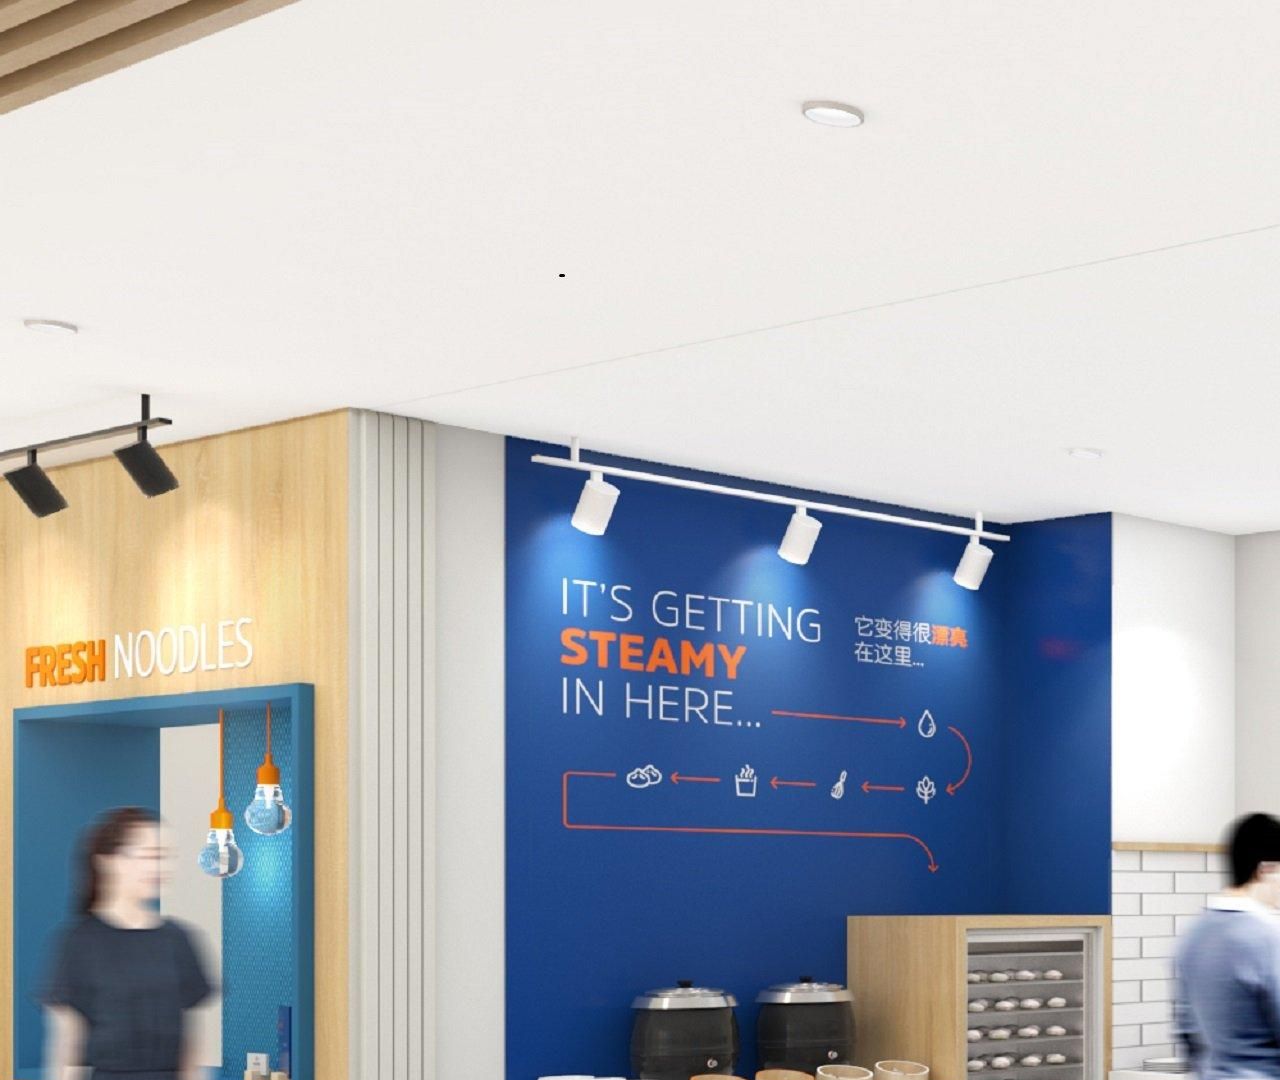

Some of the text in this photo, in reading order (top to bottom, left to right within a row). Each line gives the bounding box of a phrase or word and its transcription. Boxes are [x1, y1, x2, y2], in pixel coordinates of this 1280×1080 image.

[562, 577, 822, 643] IT'S GETTING
[25, 616, 254, 688] FRESH NOODLES
[560, 627, 748, 680] STEAMY
[562, 677, 762, 728] IN HERE...
